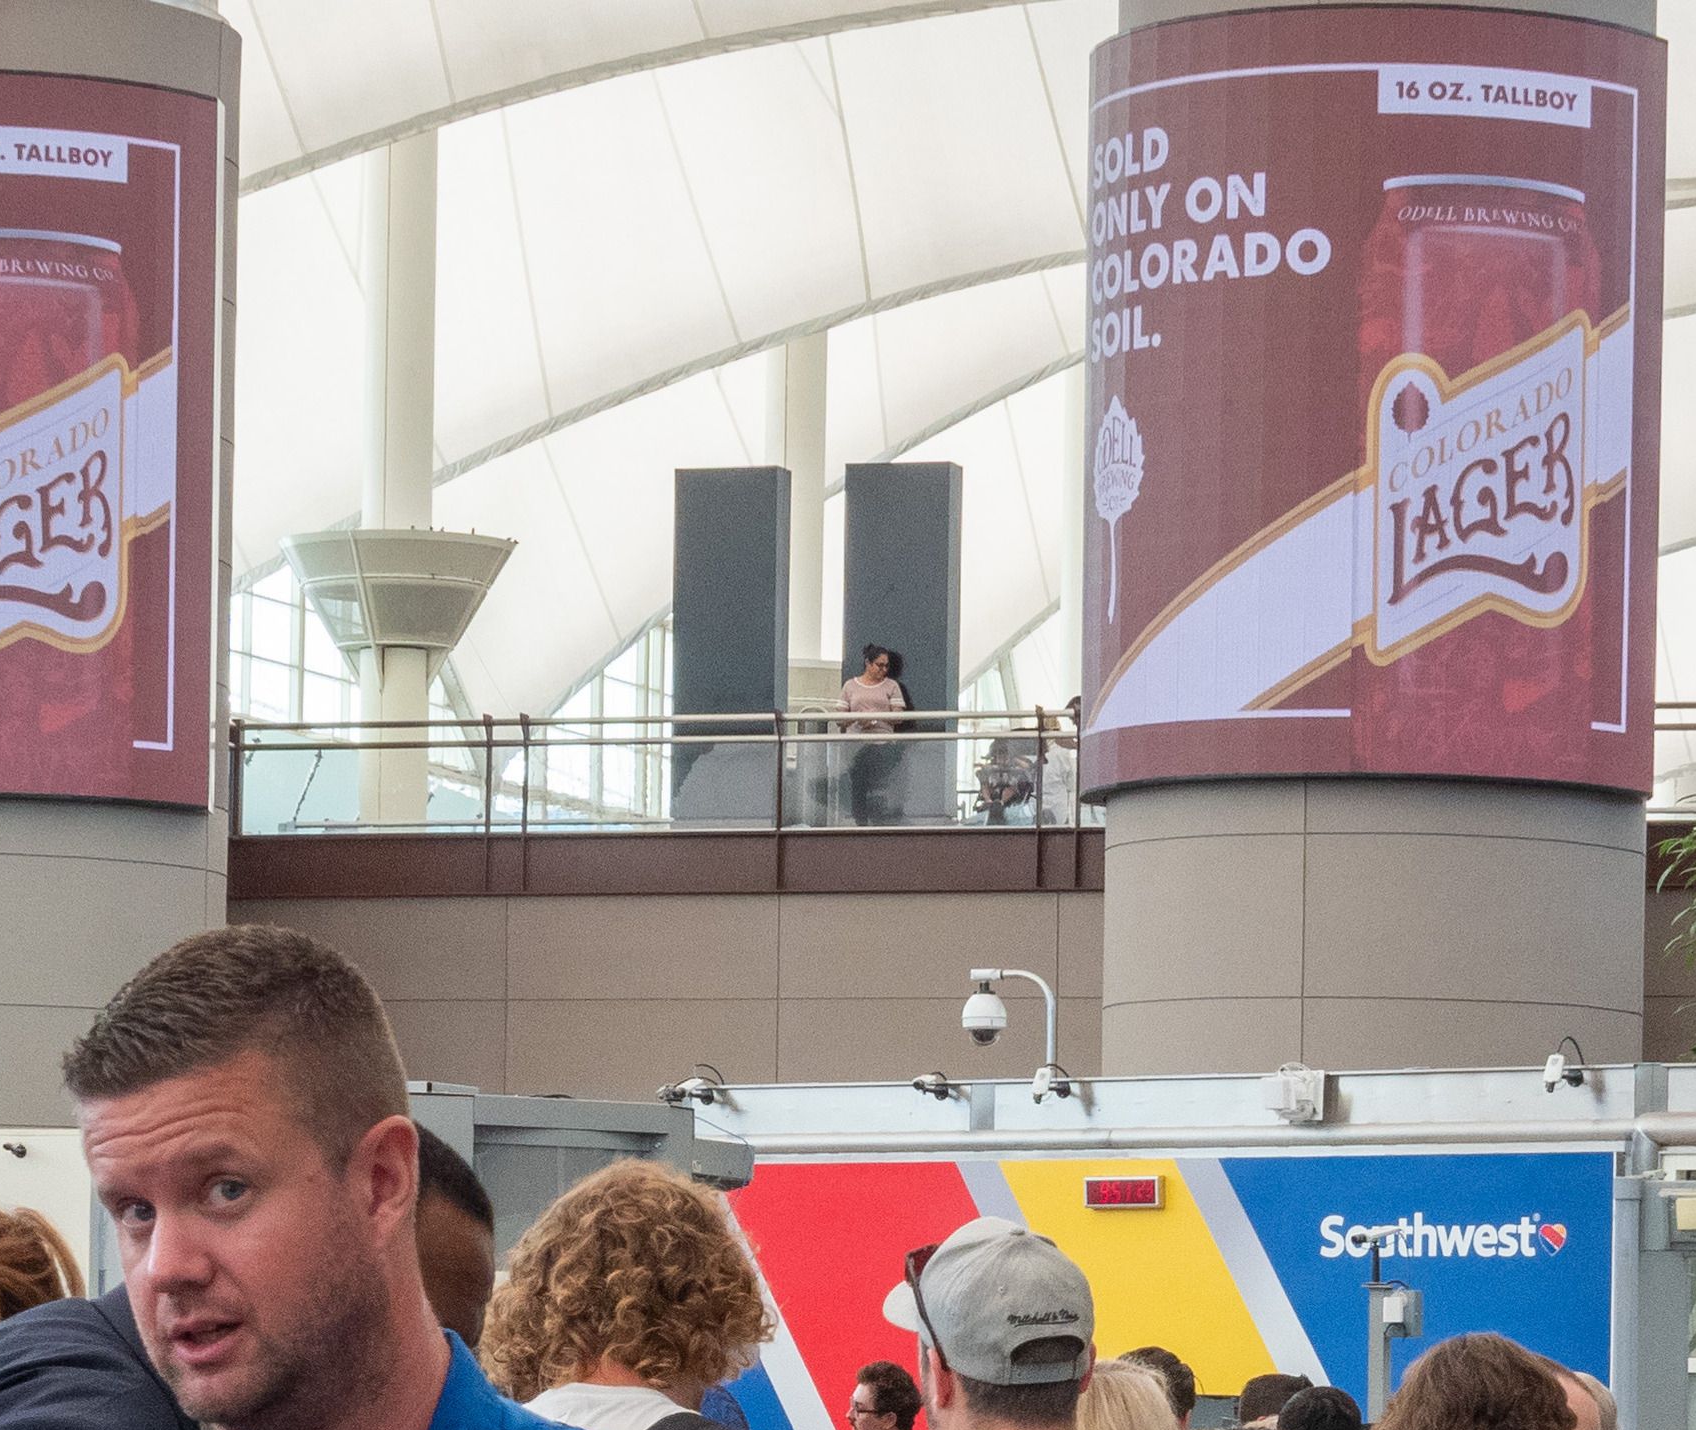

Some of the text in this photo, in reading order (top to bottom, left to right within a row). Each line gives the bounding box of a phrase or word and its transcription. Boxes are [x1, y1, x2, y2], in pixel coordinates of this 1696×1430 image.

[1396, 81, 1578, 111] 16 OZ. TALLBOY
[13, 143, 113, 168] TALLBOY
[1093, 126, 1169, 190] SOLD
[1091, 171, 1266, 247] ONLY ON
[1398, 205, 1457, 222] ODELL
[1464, 207, 1554, 229] BREWING
[1091, 228, 1332, 306] COLORADO
[1090, 305, 1162, 363] SOIL.
[1389, 367, 1573, 493] COLORADO
[1387, 411, 1575, 606] LAGER
[1319, 1212, 1537, 1258] Southwest
